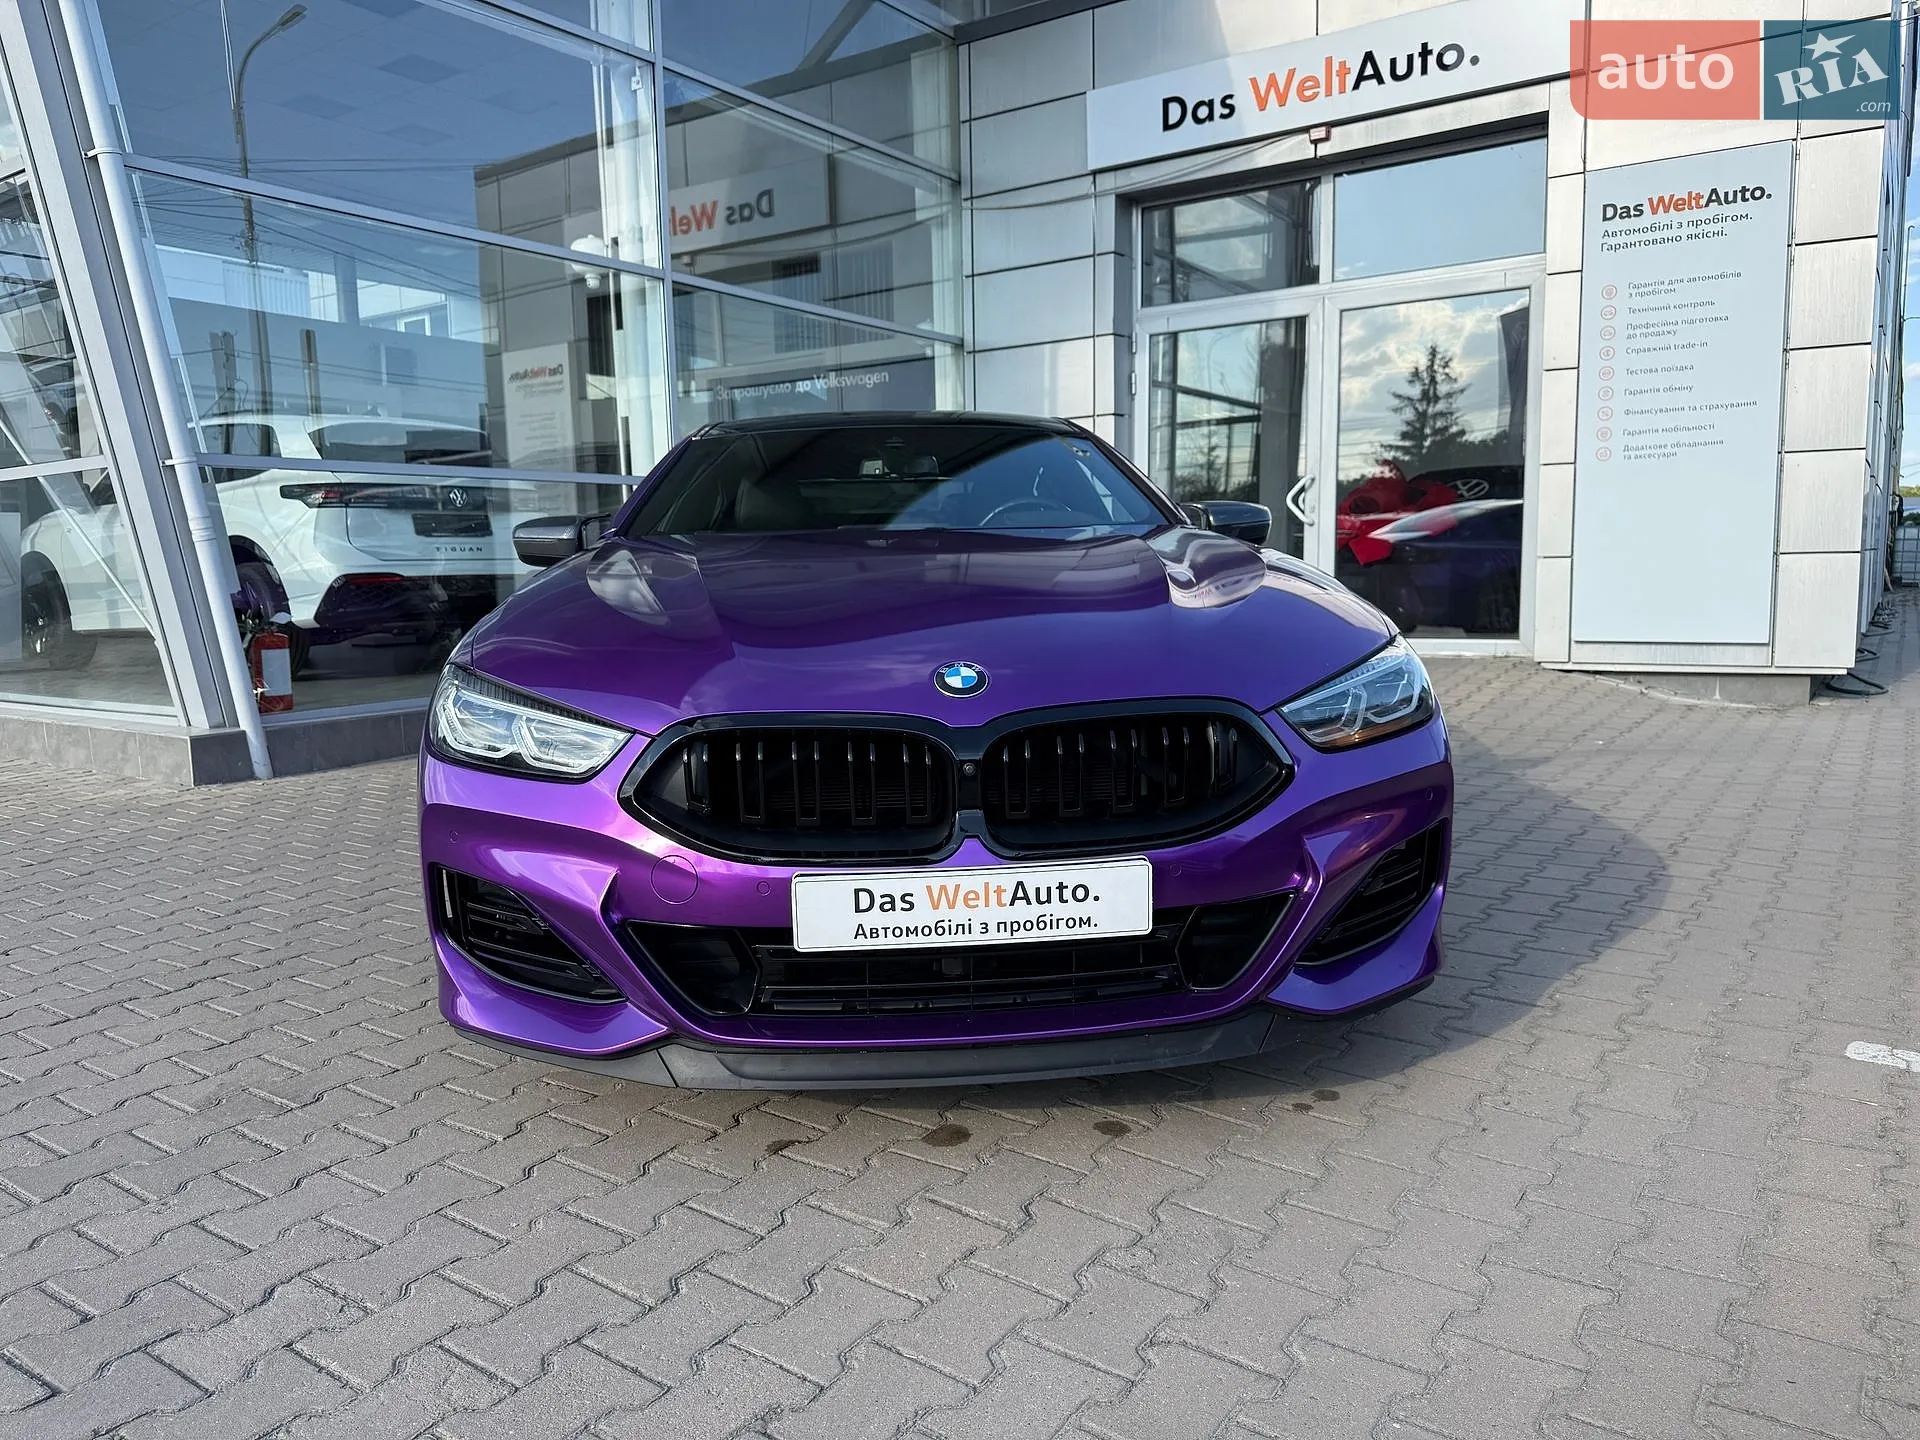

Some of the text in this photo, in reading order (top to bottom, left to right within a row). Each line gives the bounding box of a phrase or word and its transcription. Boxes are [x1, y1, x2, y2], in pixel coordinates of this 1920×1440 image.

[1162, 42, 1480, 132] Das WeltAuto.
[1602, 185, 1772, 222] Das WeltAuto.
[1602, 212, 1753, 239] Автомобілі з пробігом.
[1601, 227, 1727, 252] Гарантовано якісні.
[1628, 270, 1742, 290] Гарантія для автомобілів
[1635, 287, 1676, 298] пробігом
[1627, 300, 1716, 315] Технічний контроль
[1626, 315, 1729, 331] Професійна підготовка
[1639, 329, 1678, 339] продажу
[1673, 341, 1708, 350] trade-in
[1625, 366, 1659, 376] Тестова
[795, 379, 812, 393] до
[814, 371, 889, 389] Volkswagen
[1623, 386, 1661, 397] Гарантія
[434, 545, 483, 553] TIGUAN
[853, 880, 1100, 914] Das WeltAuto.
[853, 913, 1098, 940] Автомобілі з пробігом.
